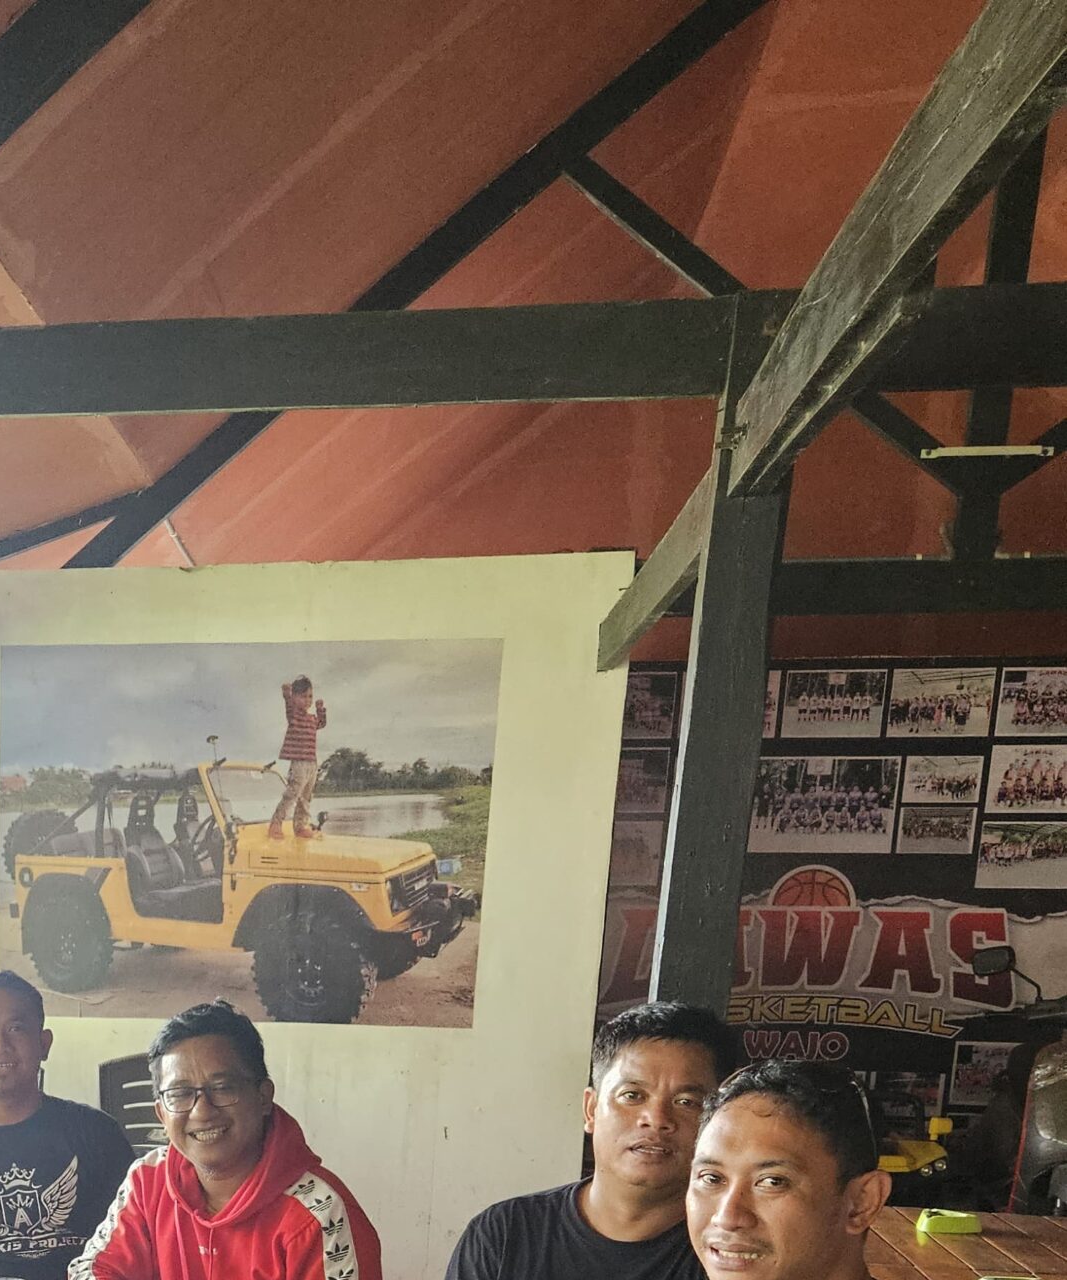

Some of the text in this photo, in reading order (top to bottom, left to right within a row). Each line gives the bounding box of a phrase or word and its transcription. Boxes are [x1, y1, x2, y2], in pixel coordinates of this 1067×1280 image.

[599, 909, 1013, 1008] LWAS
[726, 996, 964, 1038] SKETBALL
[744, 1030, 850, 1061] WAJO
[15, 1207, 32, 1229] A
[29, 1237, 87, 1249] PROJECT
